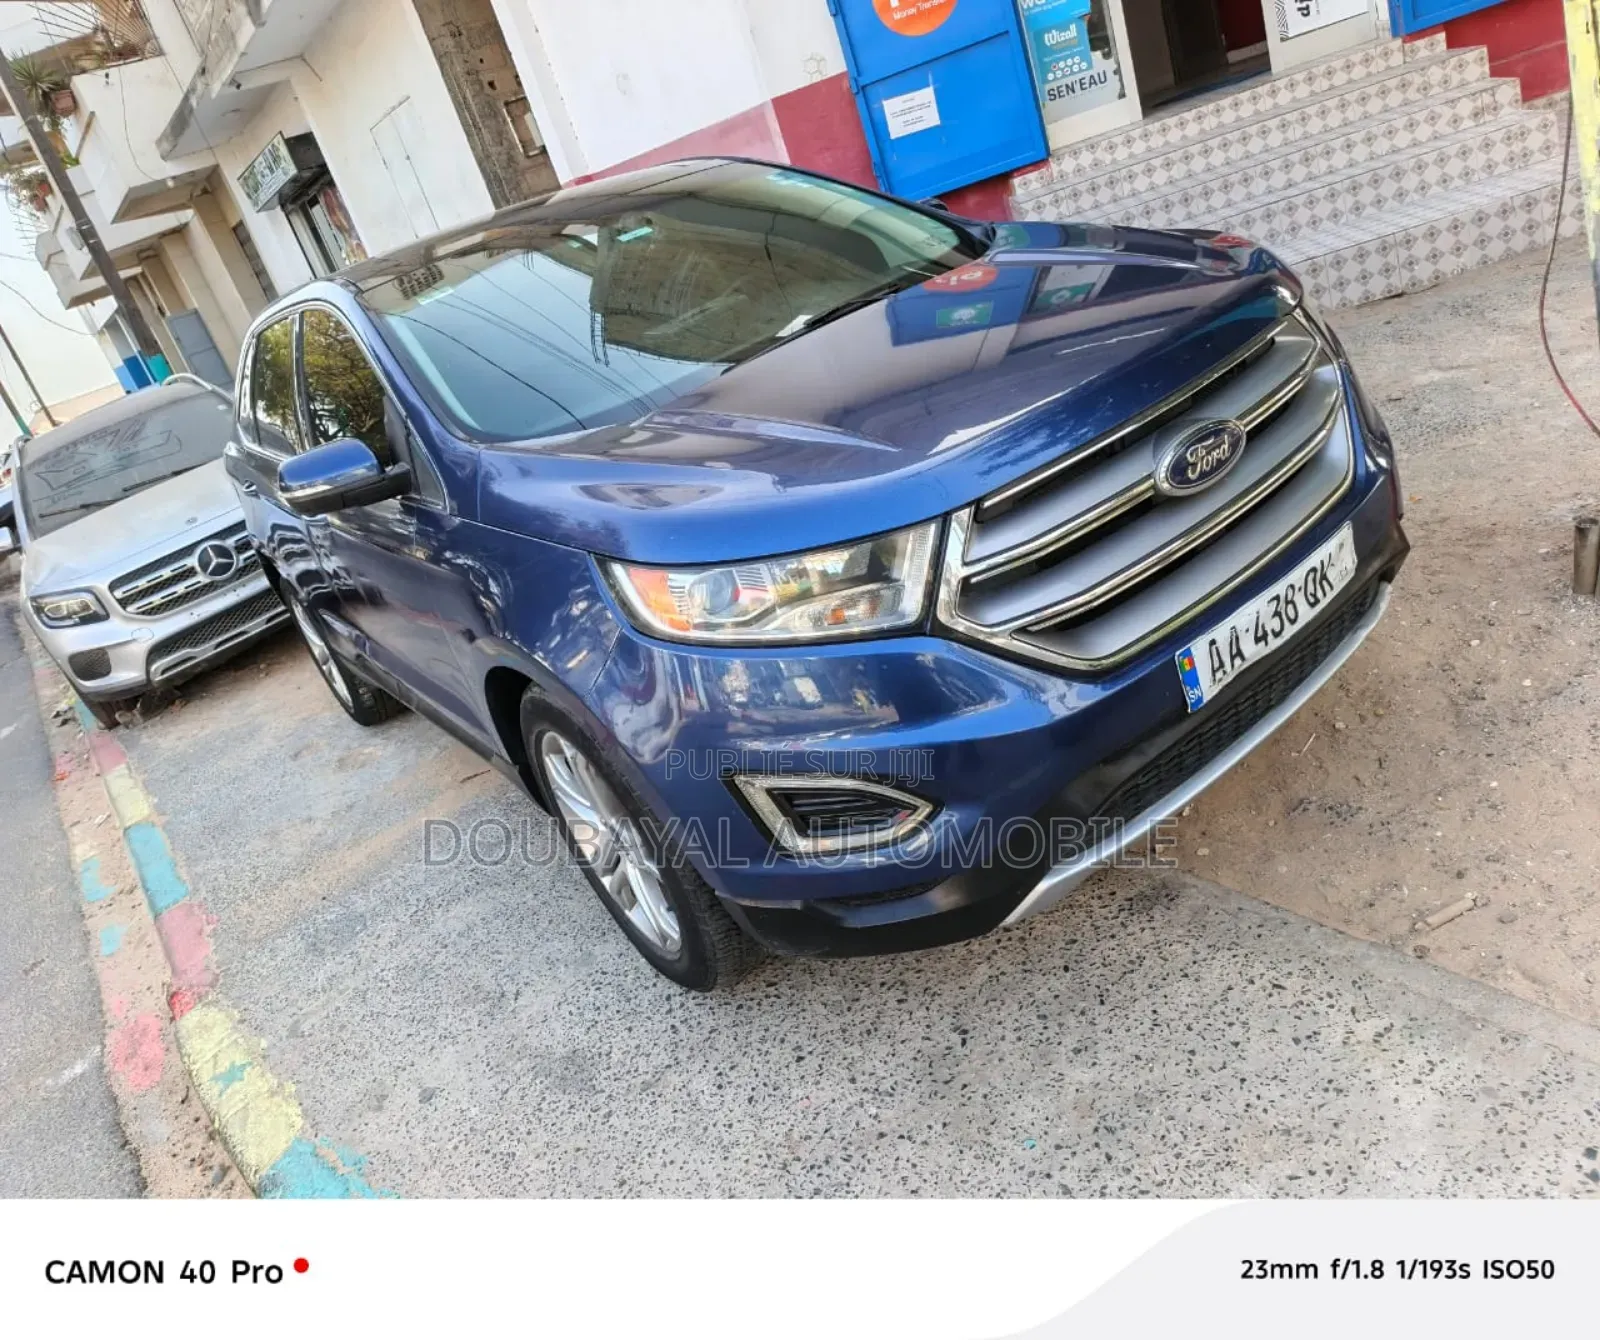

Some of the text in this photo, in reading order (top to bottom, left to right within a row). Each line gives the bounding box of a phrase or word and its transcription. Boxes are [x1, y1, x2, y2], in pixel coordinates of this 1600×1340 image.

[1044, 23, 1077, 46] Wizall
[1047, 69, 1108, 101] SEN'EAU
[1186, 434, 1231, 480] Ford
[1188, 685, 1203, 703] SN
